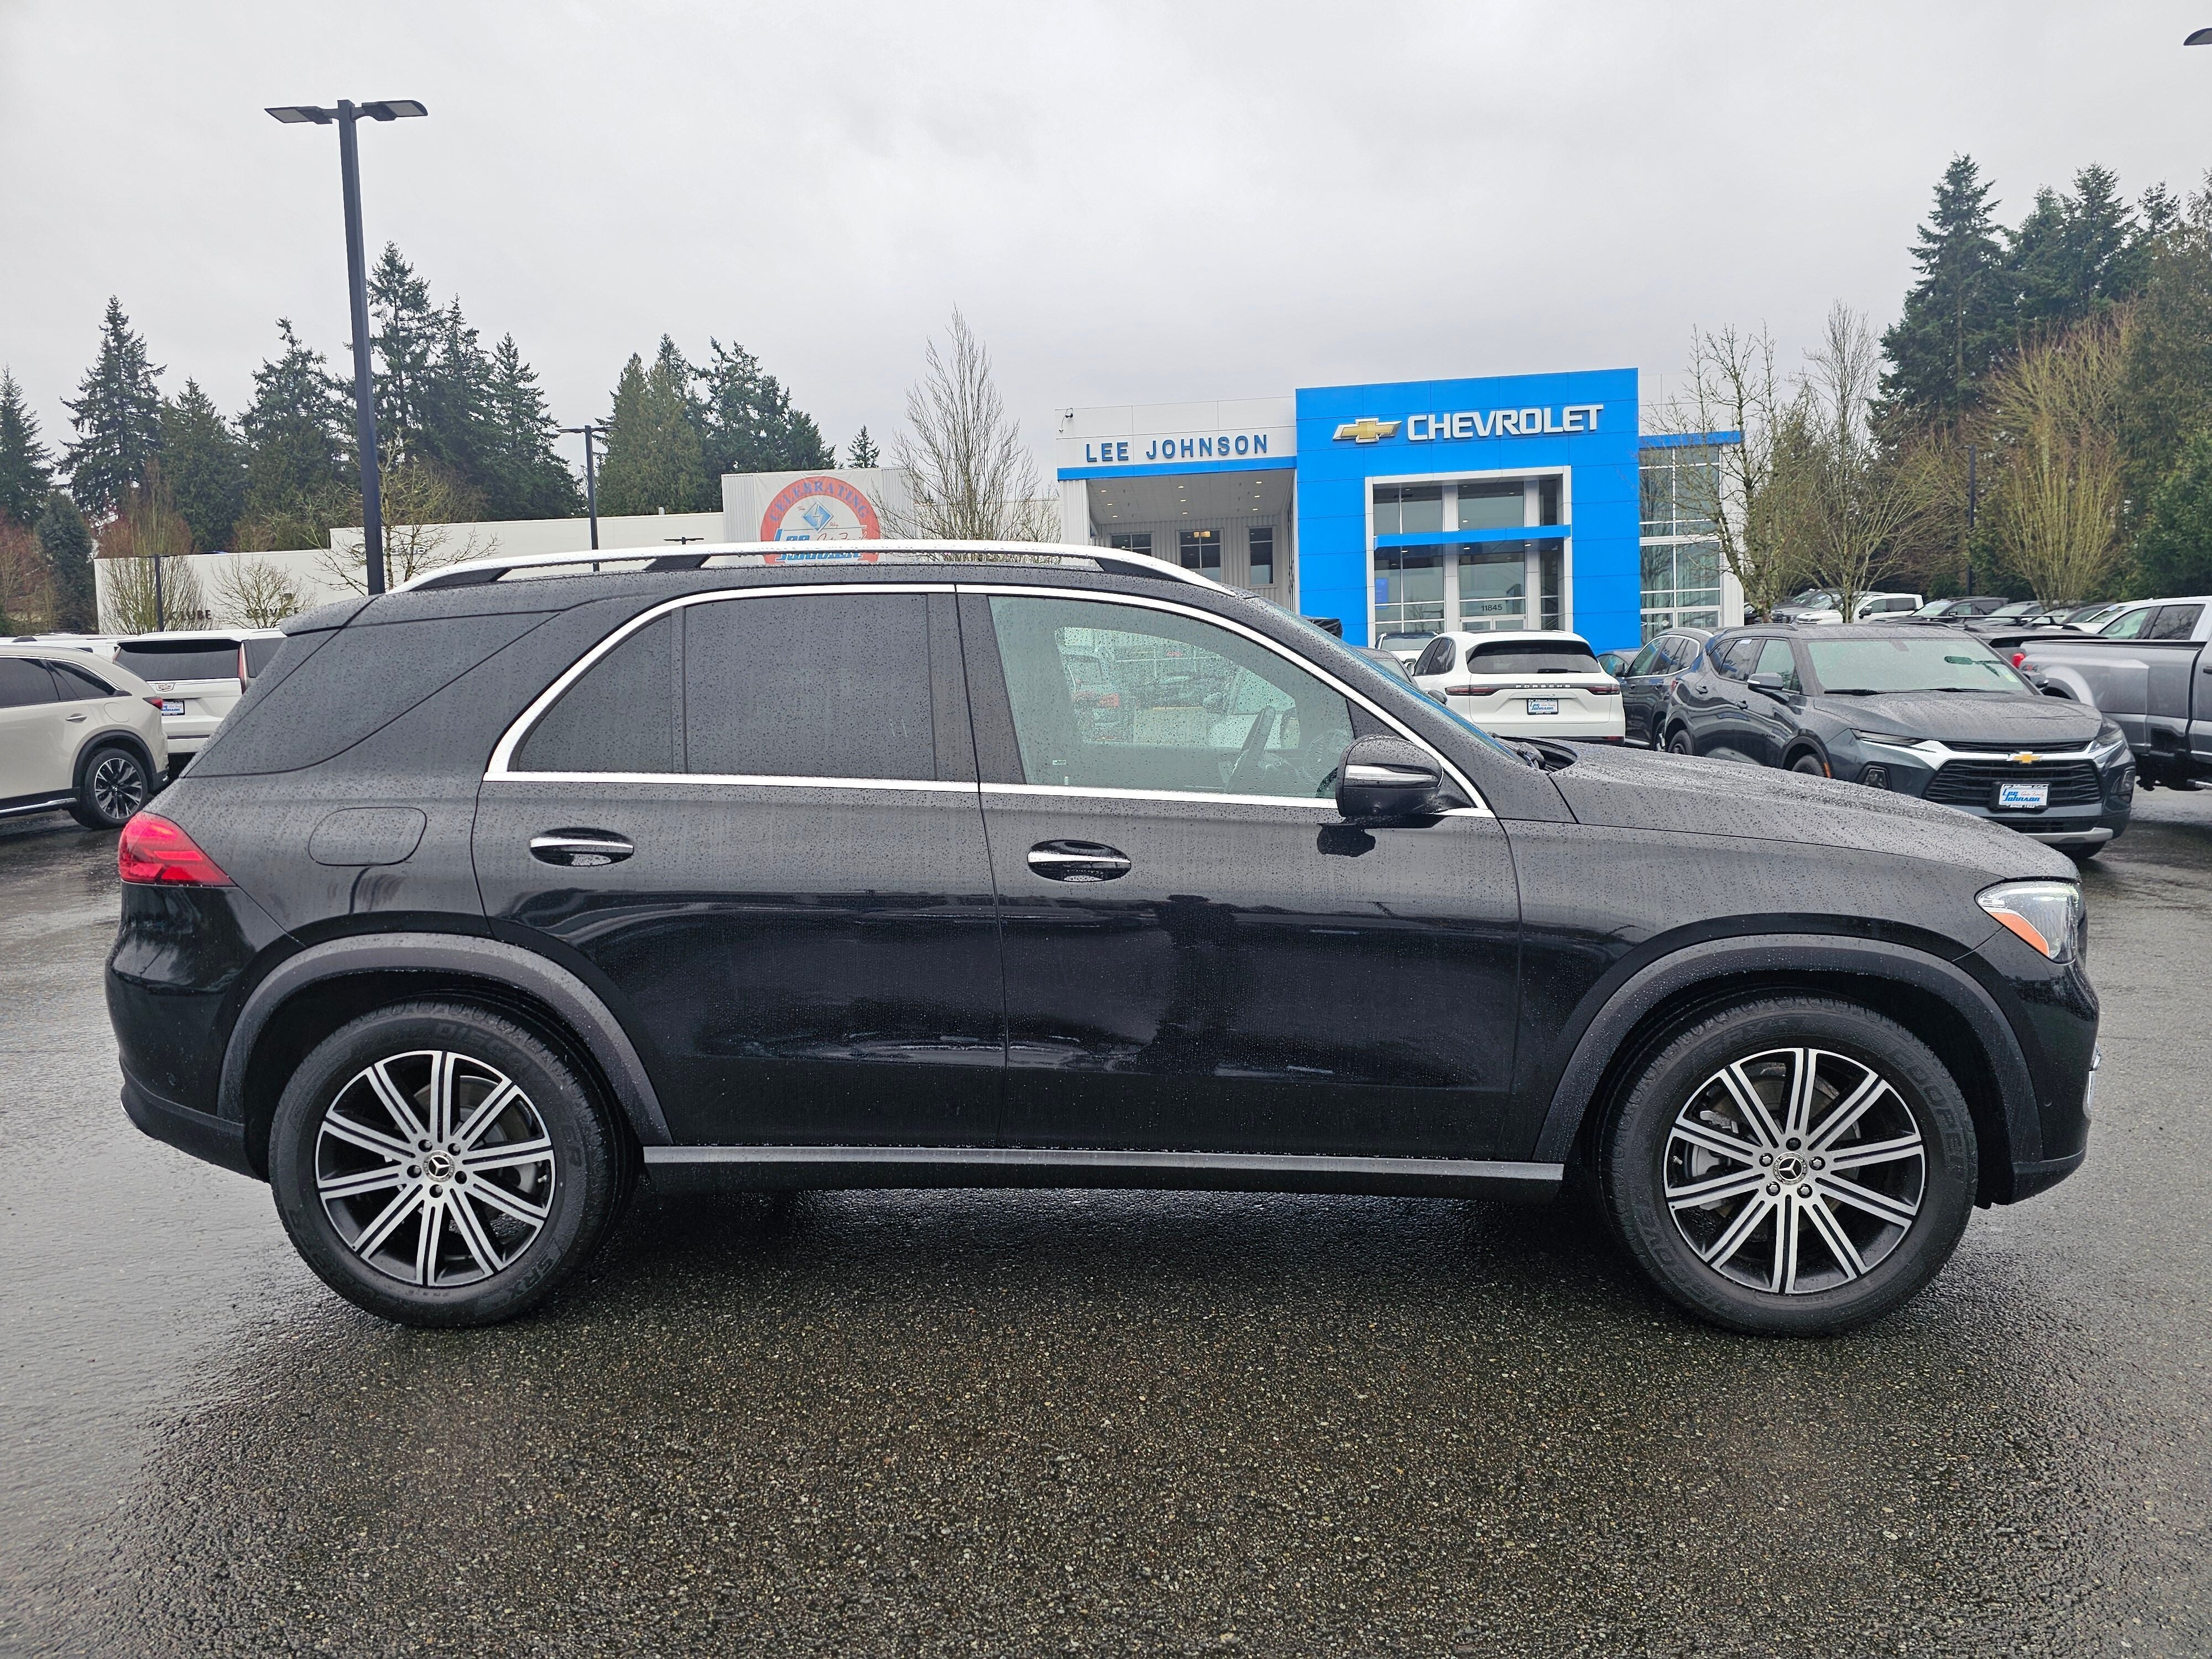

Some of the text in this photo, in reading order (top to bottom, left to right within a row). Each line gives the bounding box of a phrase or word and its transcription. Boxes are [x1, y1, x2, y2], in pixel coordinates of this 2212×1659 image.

[1407, 404, 1604, 440] CHEVROLET
[1086, 434, 1267, 462] LEE JOHNSON
[769, 481, 869, 521] CELEBRATING
[2002, 793, 2041, 802] Johnson
